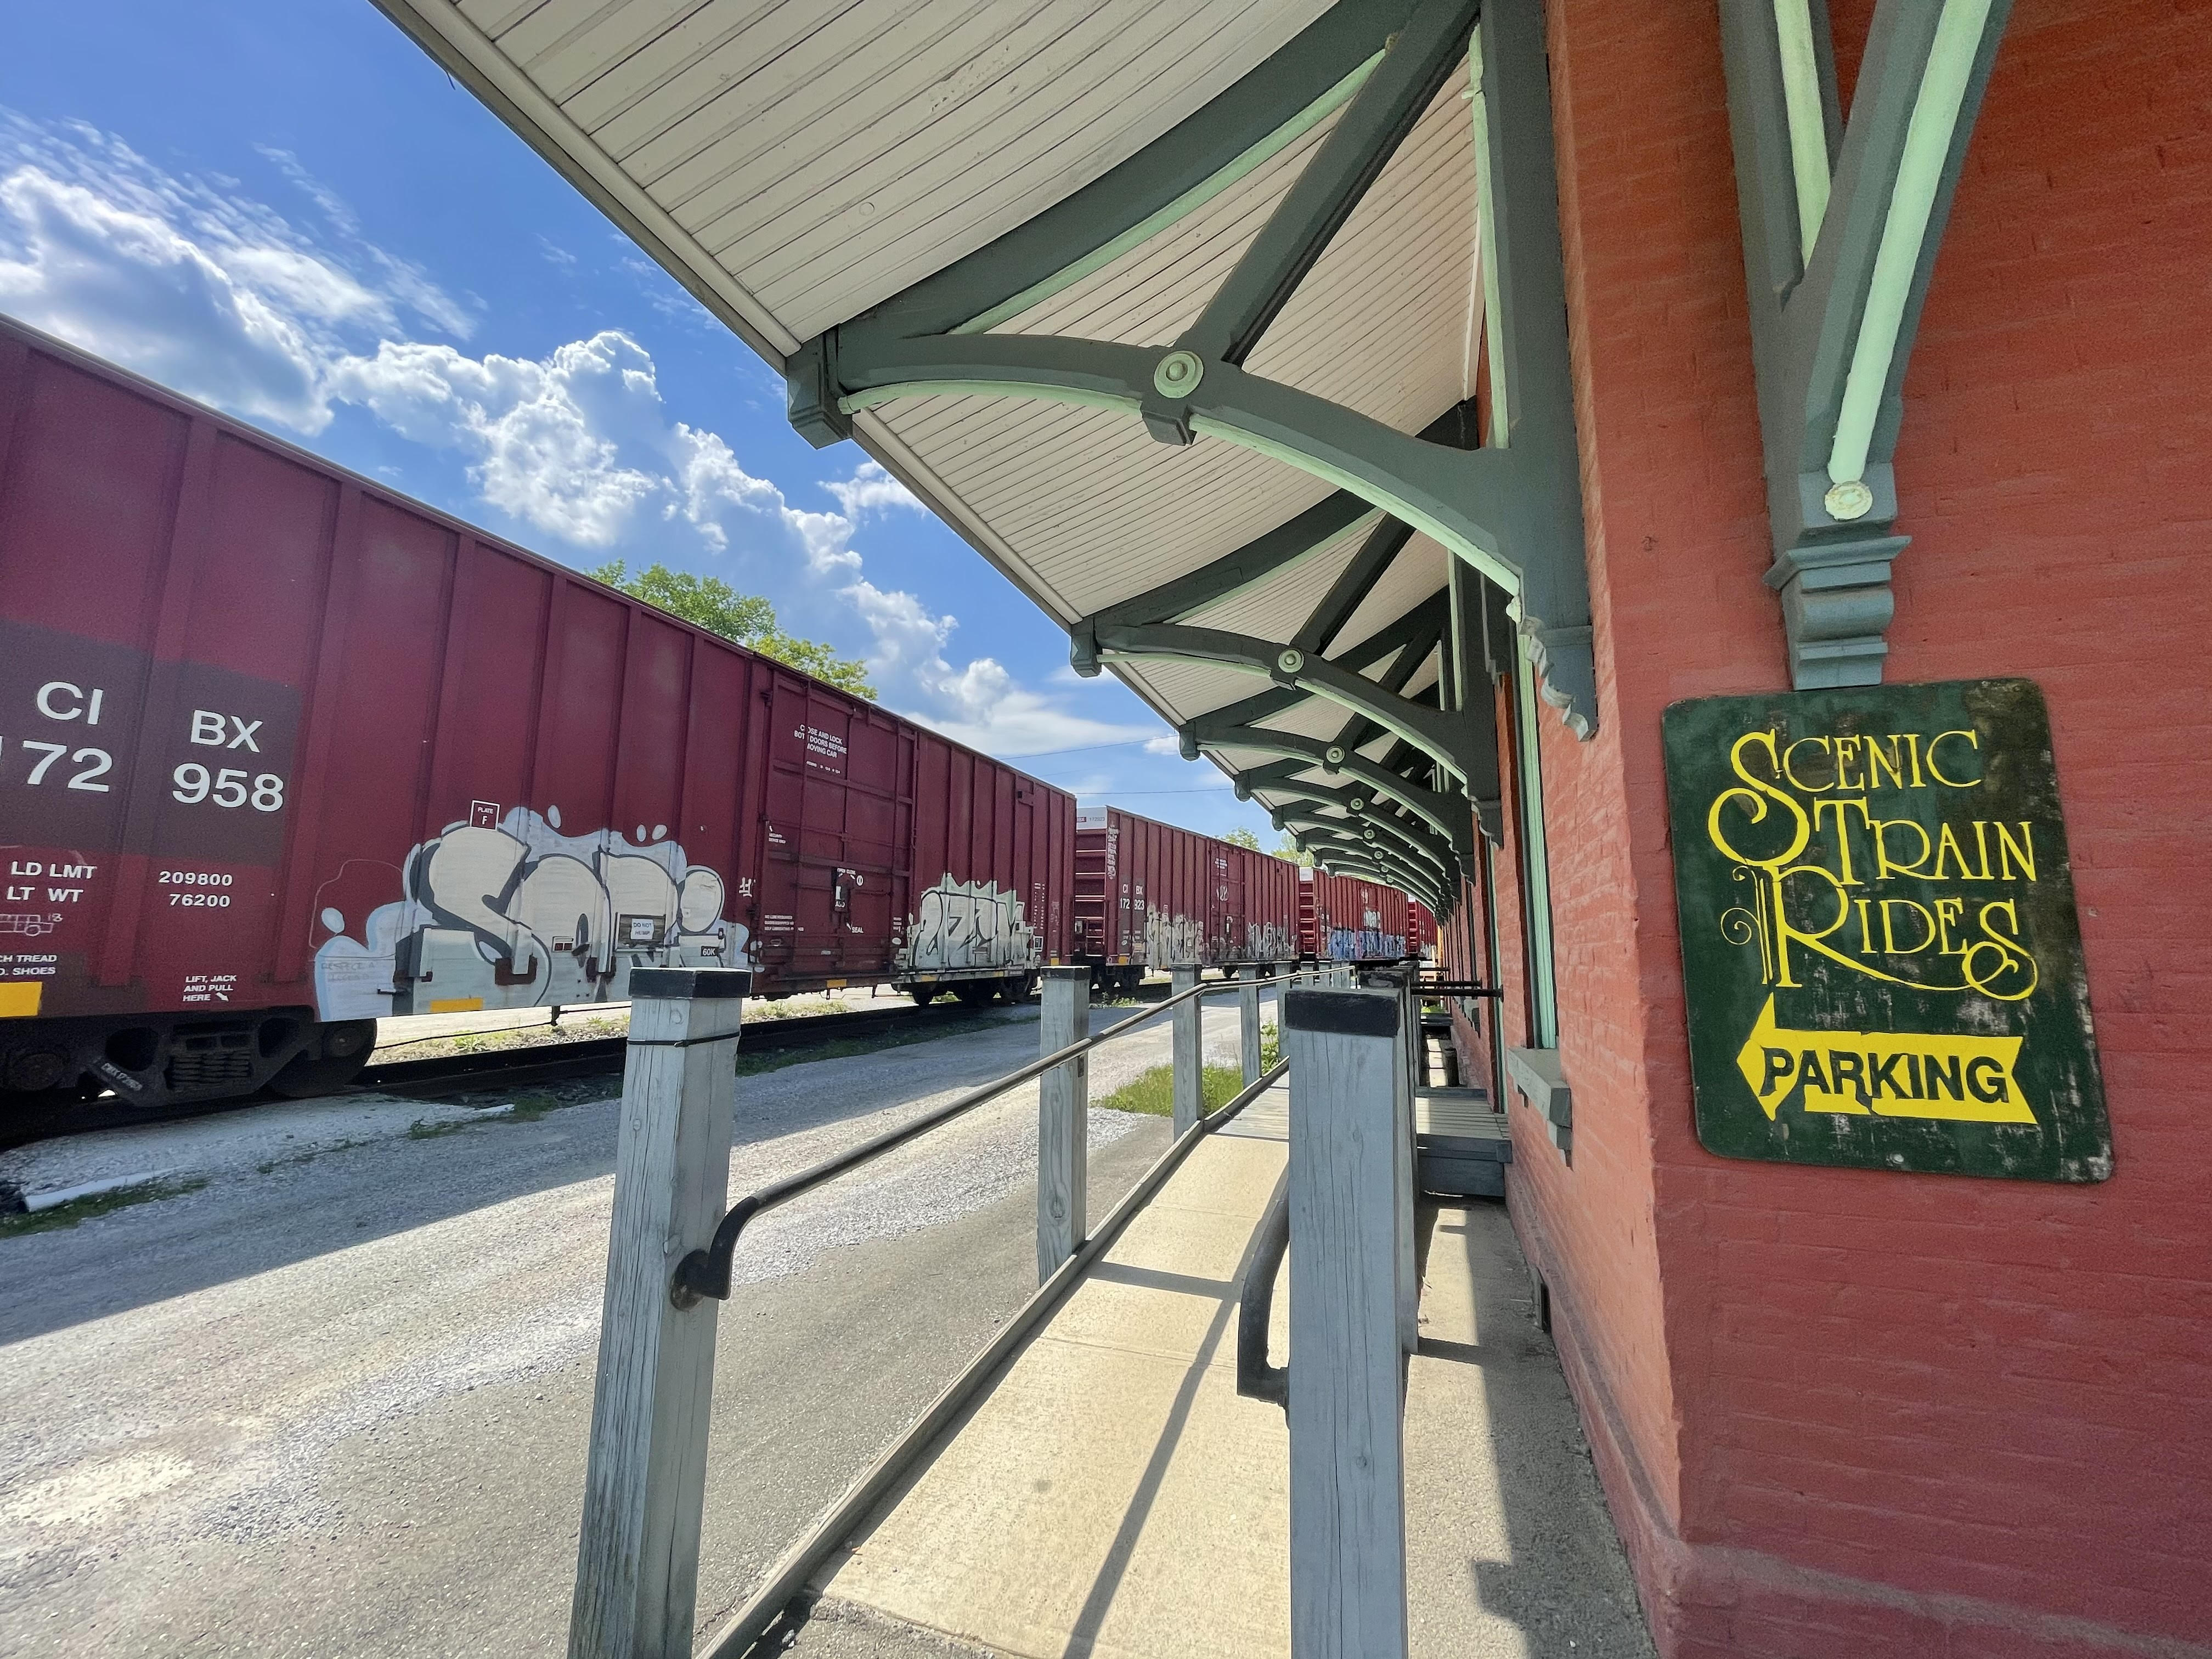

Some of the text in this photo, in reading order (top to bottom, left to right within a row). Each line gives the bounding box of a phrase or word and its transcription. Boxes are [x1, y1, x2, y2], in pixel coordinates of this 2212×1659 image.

[37, 681, 263, 753] CI BX
[800, 724, 843, 745] COSE AND LOCK
[809, 735, 828, 748] DOORS
[828, 742, 847, 754] BEFORE
[826, 749, 837, 758] CAR
[172, 763, 284, 812] 958
[482, 815, 488, 825] F
[1814, 797, 2036, 885] TRAIN
[11, 861, 233, 887] LD LMT 209800
[7, 886, 231, 908] LT WT 76200
[1122, 883, 1143, 895] CI BX
[1120, 898, 1144, 910] 172 923
[1722, 865, 2038, 1001] RIDES
[13, 967, 56, 975] SHOES
[185, 975, 208, 984] LIFT,
[183, 994, 211, 1002] HERE
[1760, 1047, 2010, 1104] PARKING
